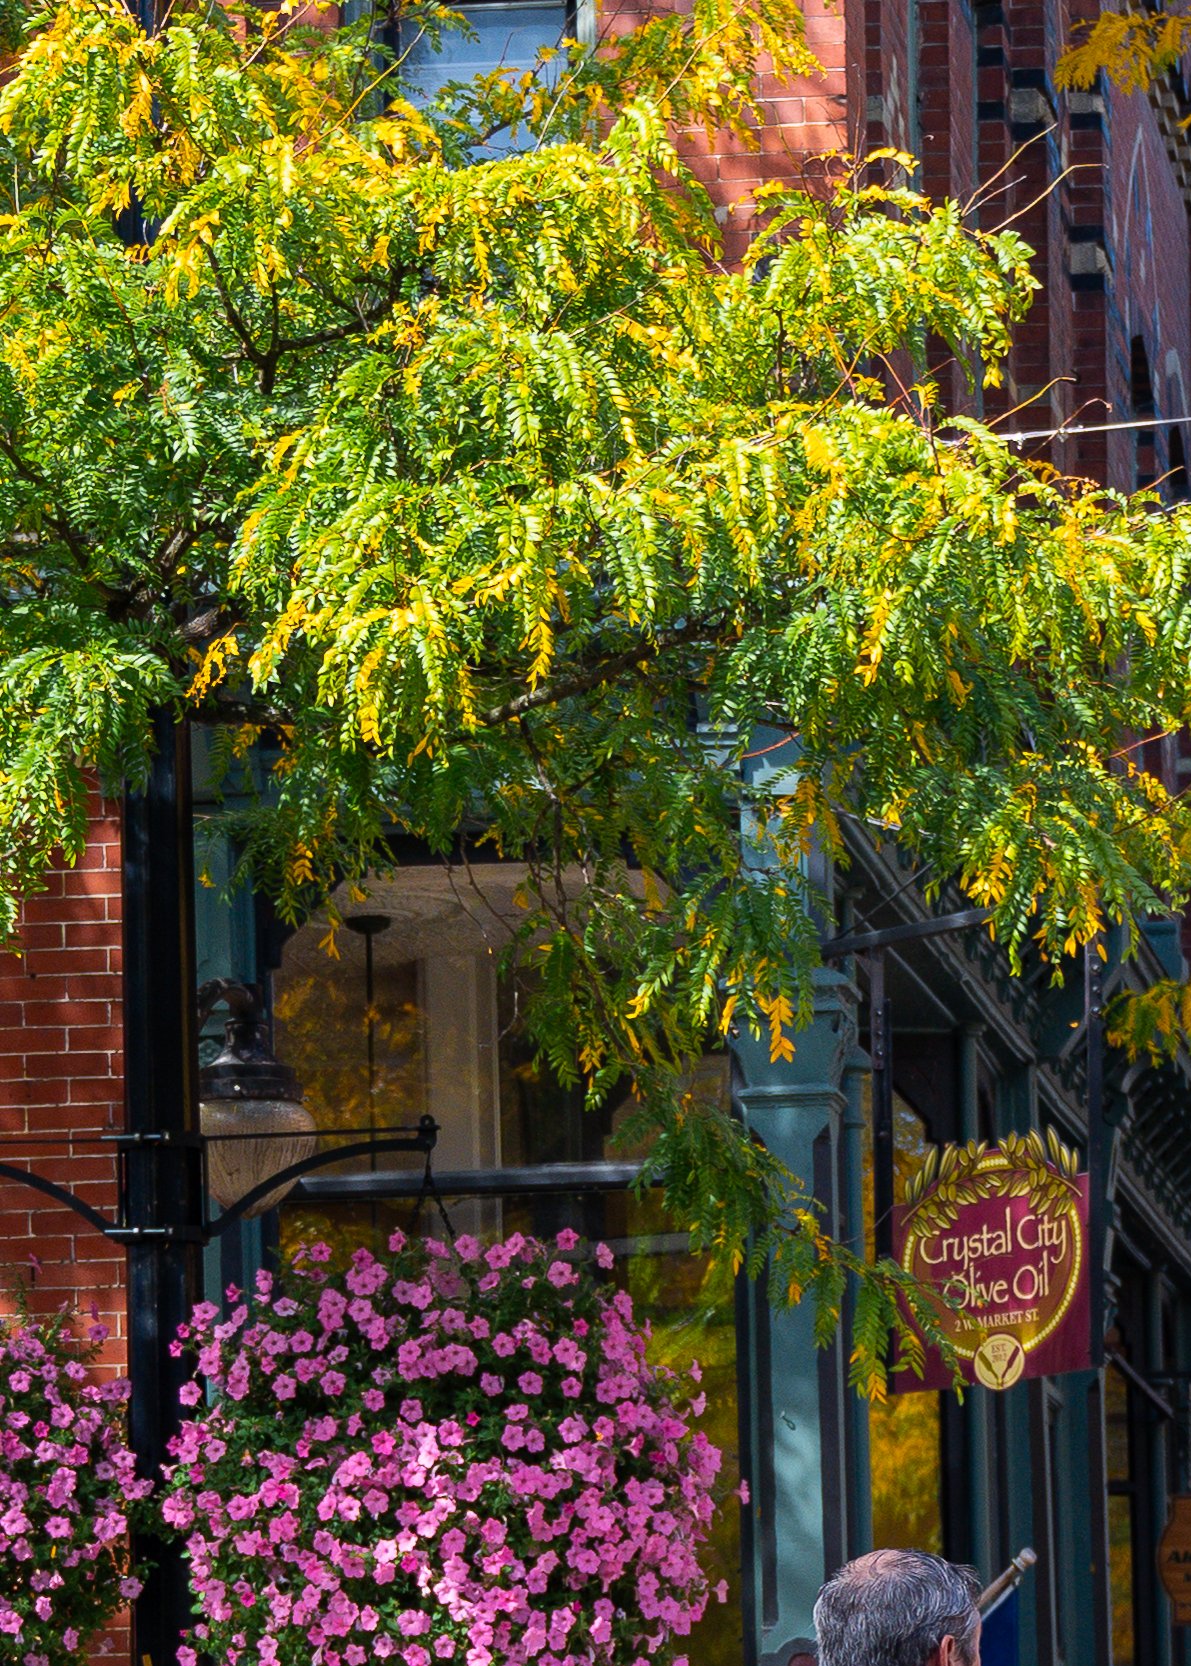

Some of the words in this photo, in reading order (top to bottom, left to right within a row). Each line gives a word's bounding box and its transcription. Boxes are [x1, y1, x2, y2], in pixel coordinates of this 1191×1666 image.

[919, 1206, 1012, 1270] Crystal
[1016, 1214, 1068, 1264] City
[942, 1261, 1009, 1310] Olive
[1012, 1252, 1049, 1301] Oil
[977, 1310, 1024, 1328] MARKET
